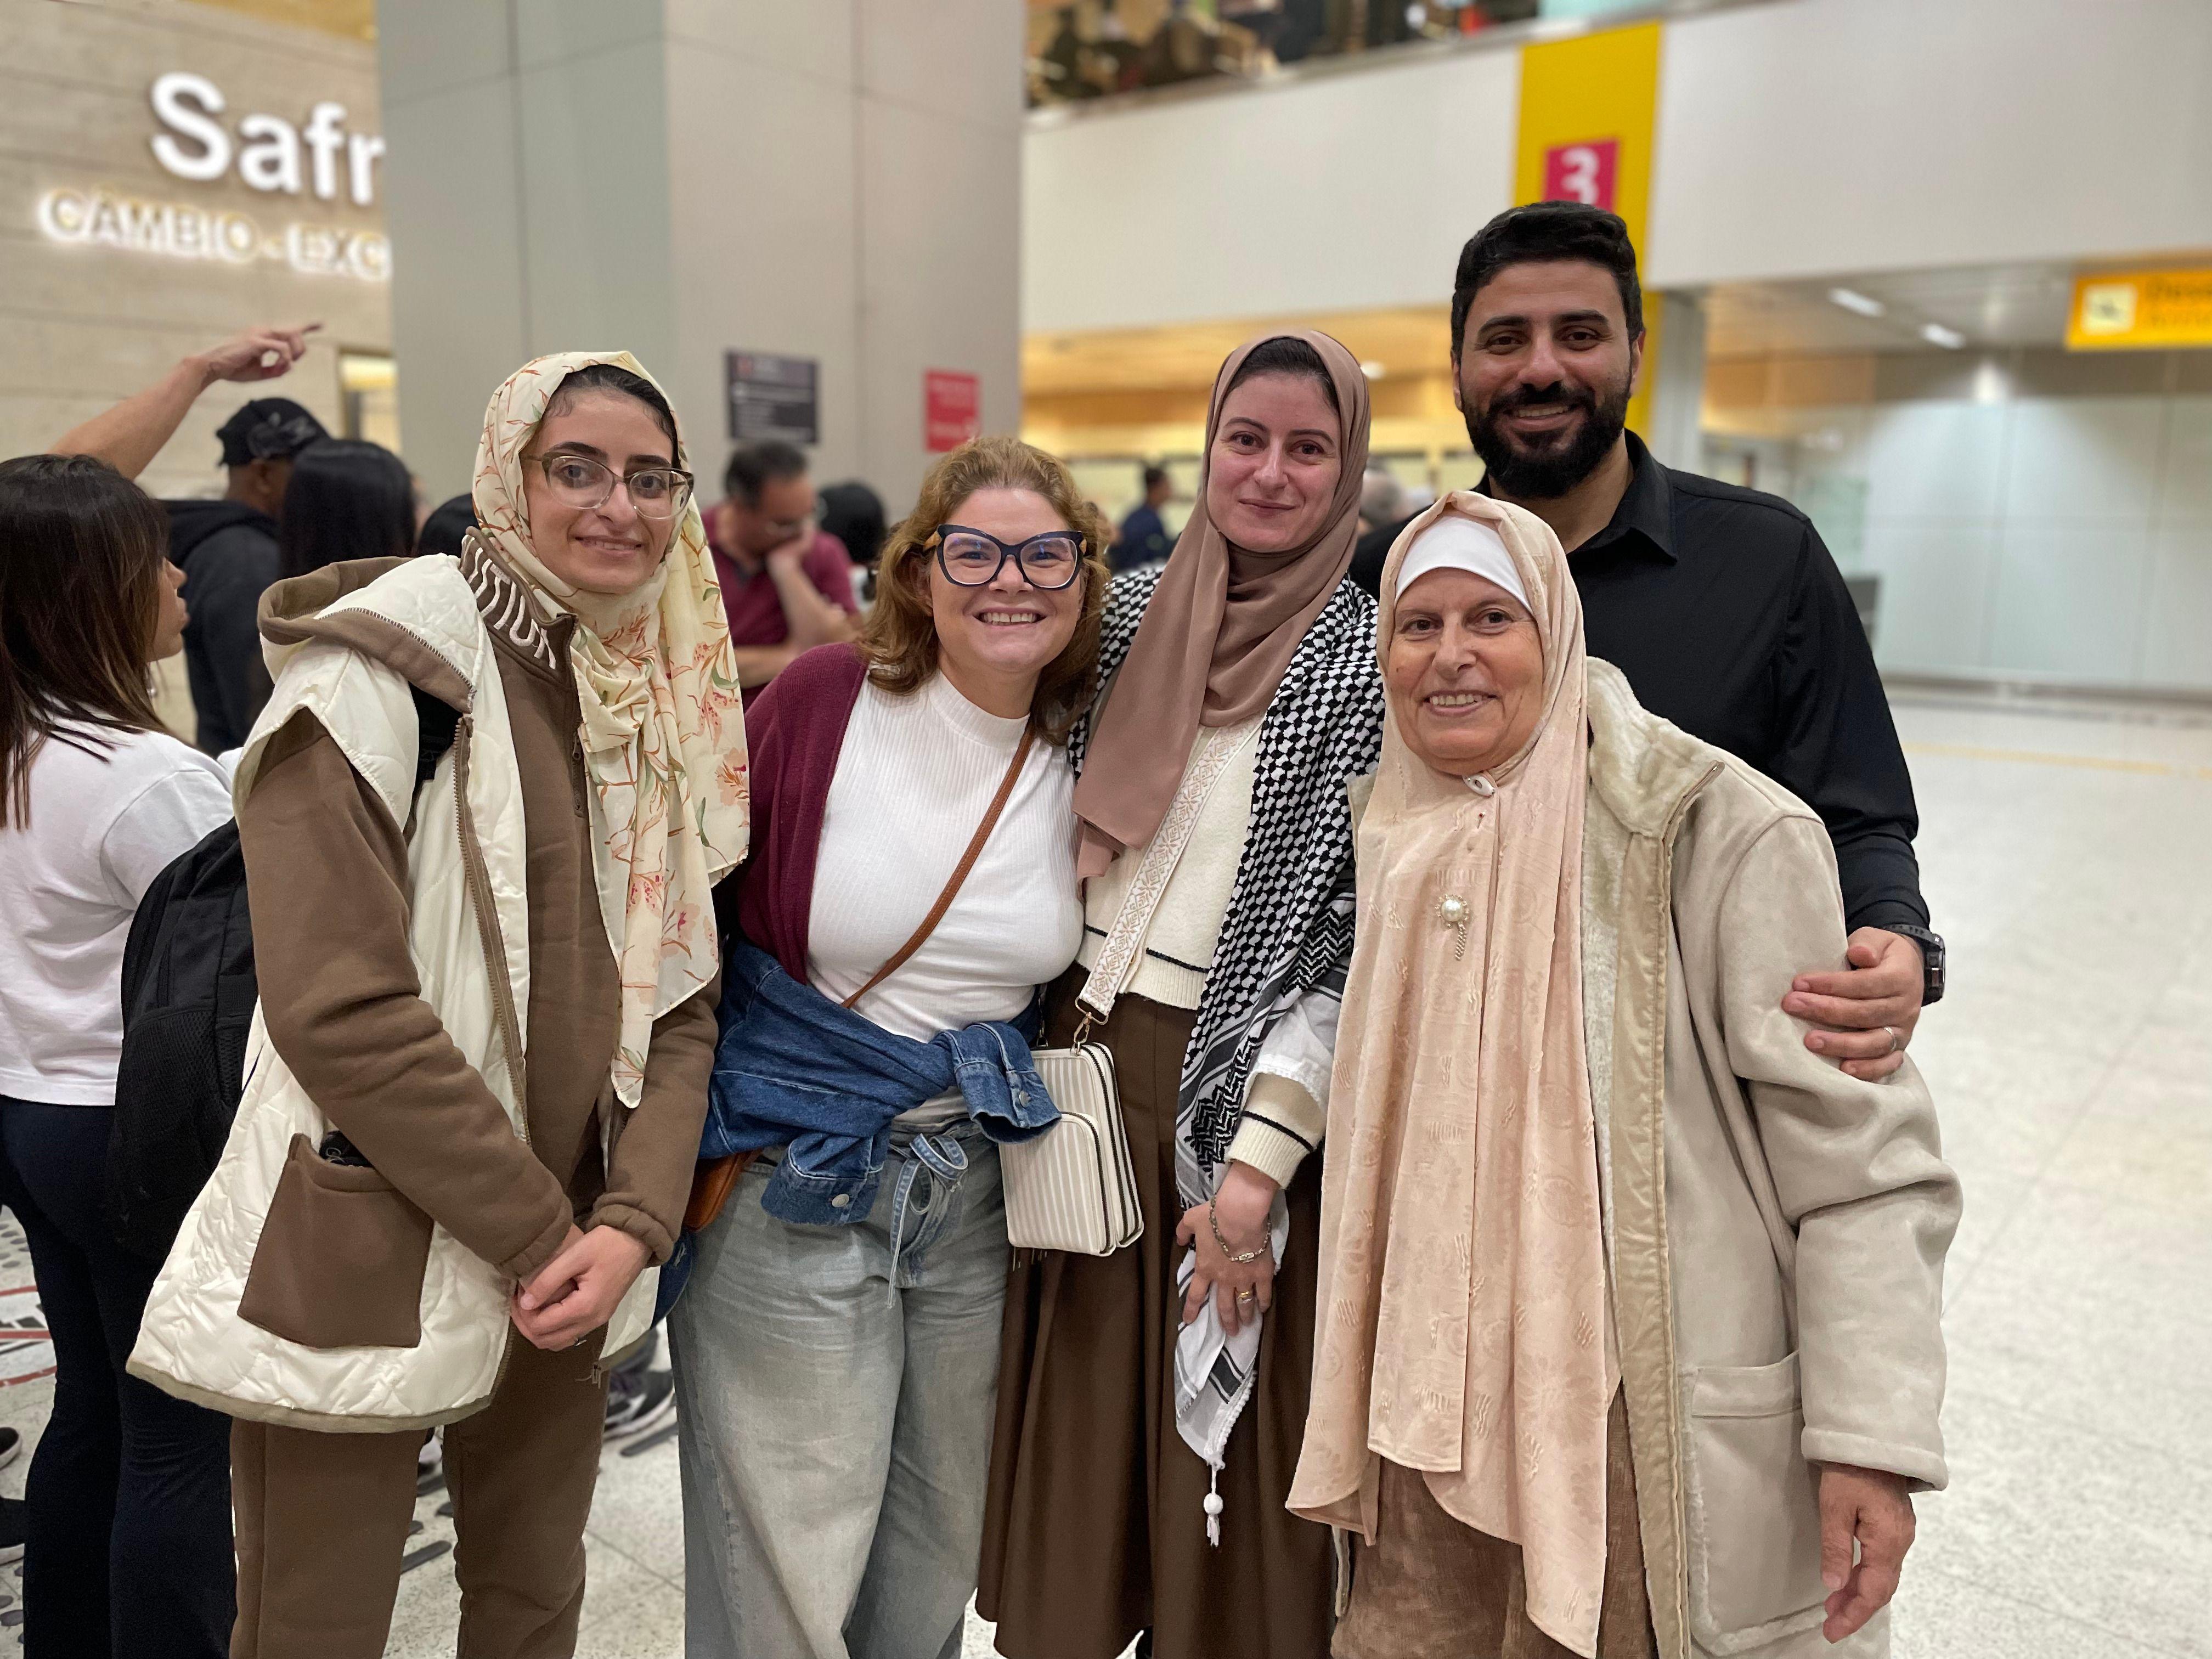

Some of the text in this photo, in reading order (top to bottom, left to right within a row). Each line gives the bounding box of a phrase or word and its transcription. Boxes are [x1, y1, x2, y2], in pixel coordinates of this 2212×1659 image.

[150, 71, 386, 206] Safr
[1560, 145, 1600, 205] 3
[37, 188, 260, 264] CAMBIO
